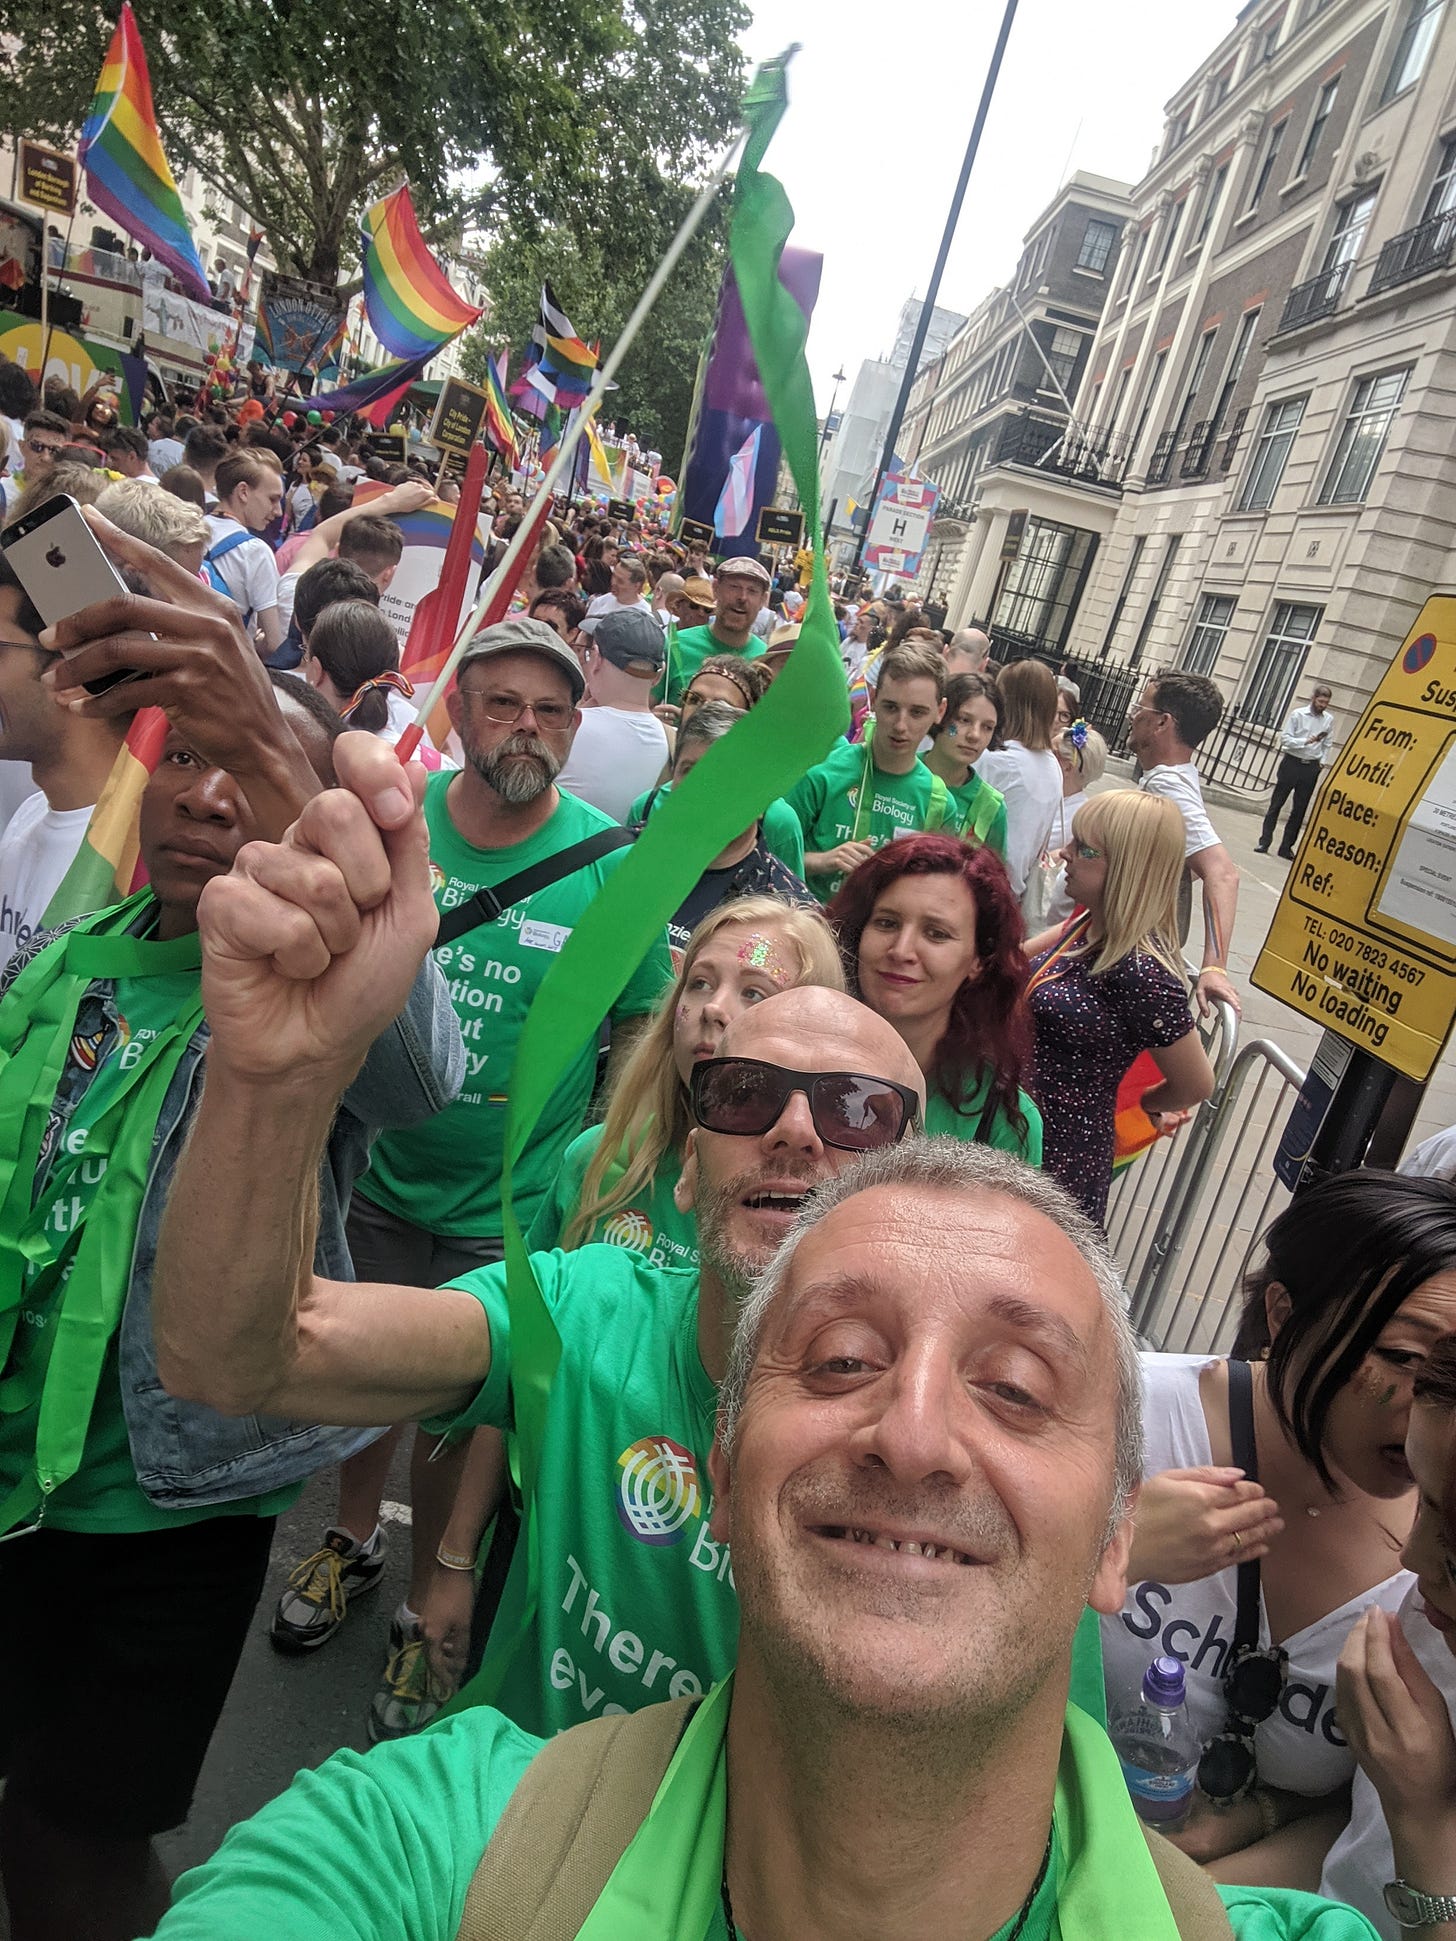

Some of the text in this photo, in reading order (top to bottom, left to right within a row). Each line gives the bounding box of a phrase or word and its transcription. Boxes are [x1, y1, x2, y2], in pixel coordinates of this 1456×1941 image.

[269, 298, 304, 318] LONDON
[892, 517, 907, 537] H
[381, 594, 402, 606] ride
[1364, 718, 1418, 751] From:
[1345, 753, 1395, 788] Until:
[872, 800, 914, 826] Biology
[875, 793, 891, 802] Royal
[1327, 789, 1379, 828] Place:
[1313, 826, 1382, 873] Reason:
[449, 877, 480, 893] Royal
[1300, 863, 1334, 897] Ref:
[432, 945, 522, 985] e's no
[1303, 915, 1426, 987] TEL: 020 7823 4567
[1303, 940, 1403, 1015] No waiting
[447, 980, 504, 1013] tion
[1290, 970, 1390, 1047] No loading
[656, 1232, 690, 1258] Royal
